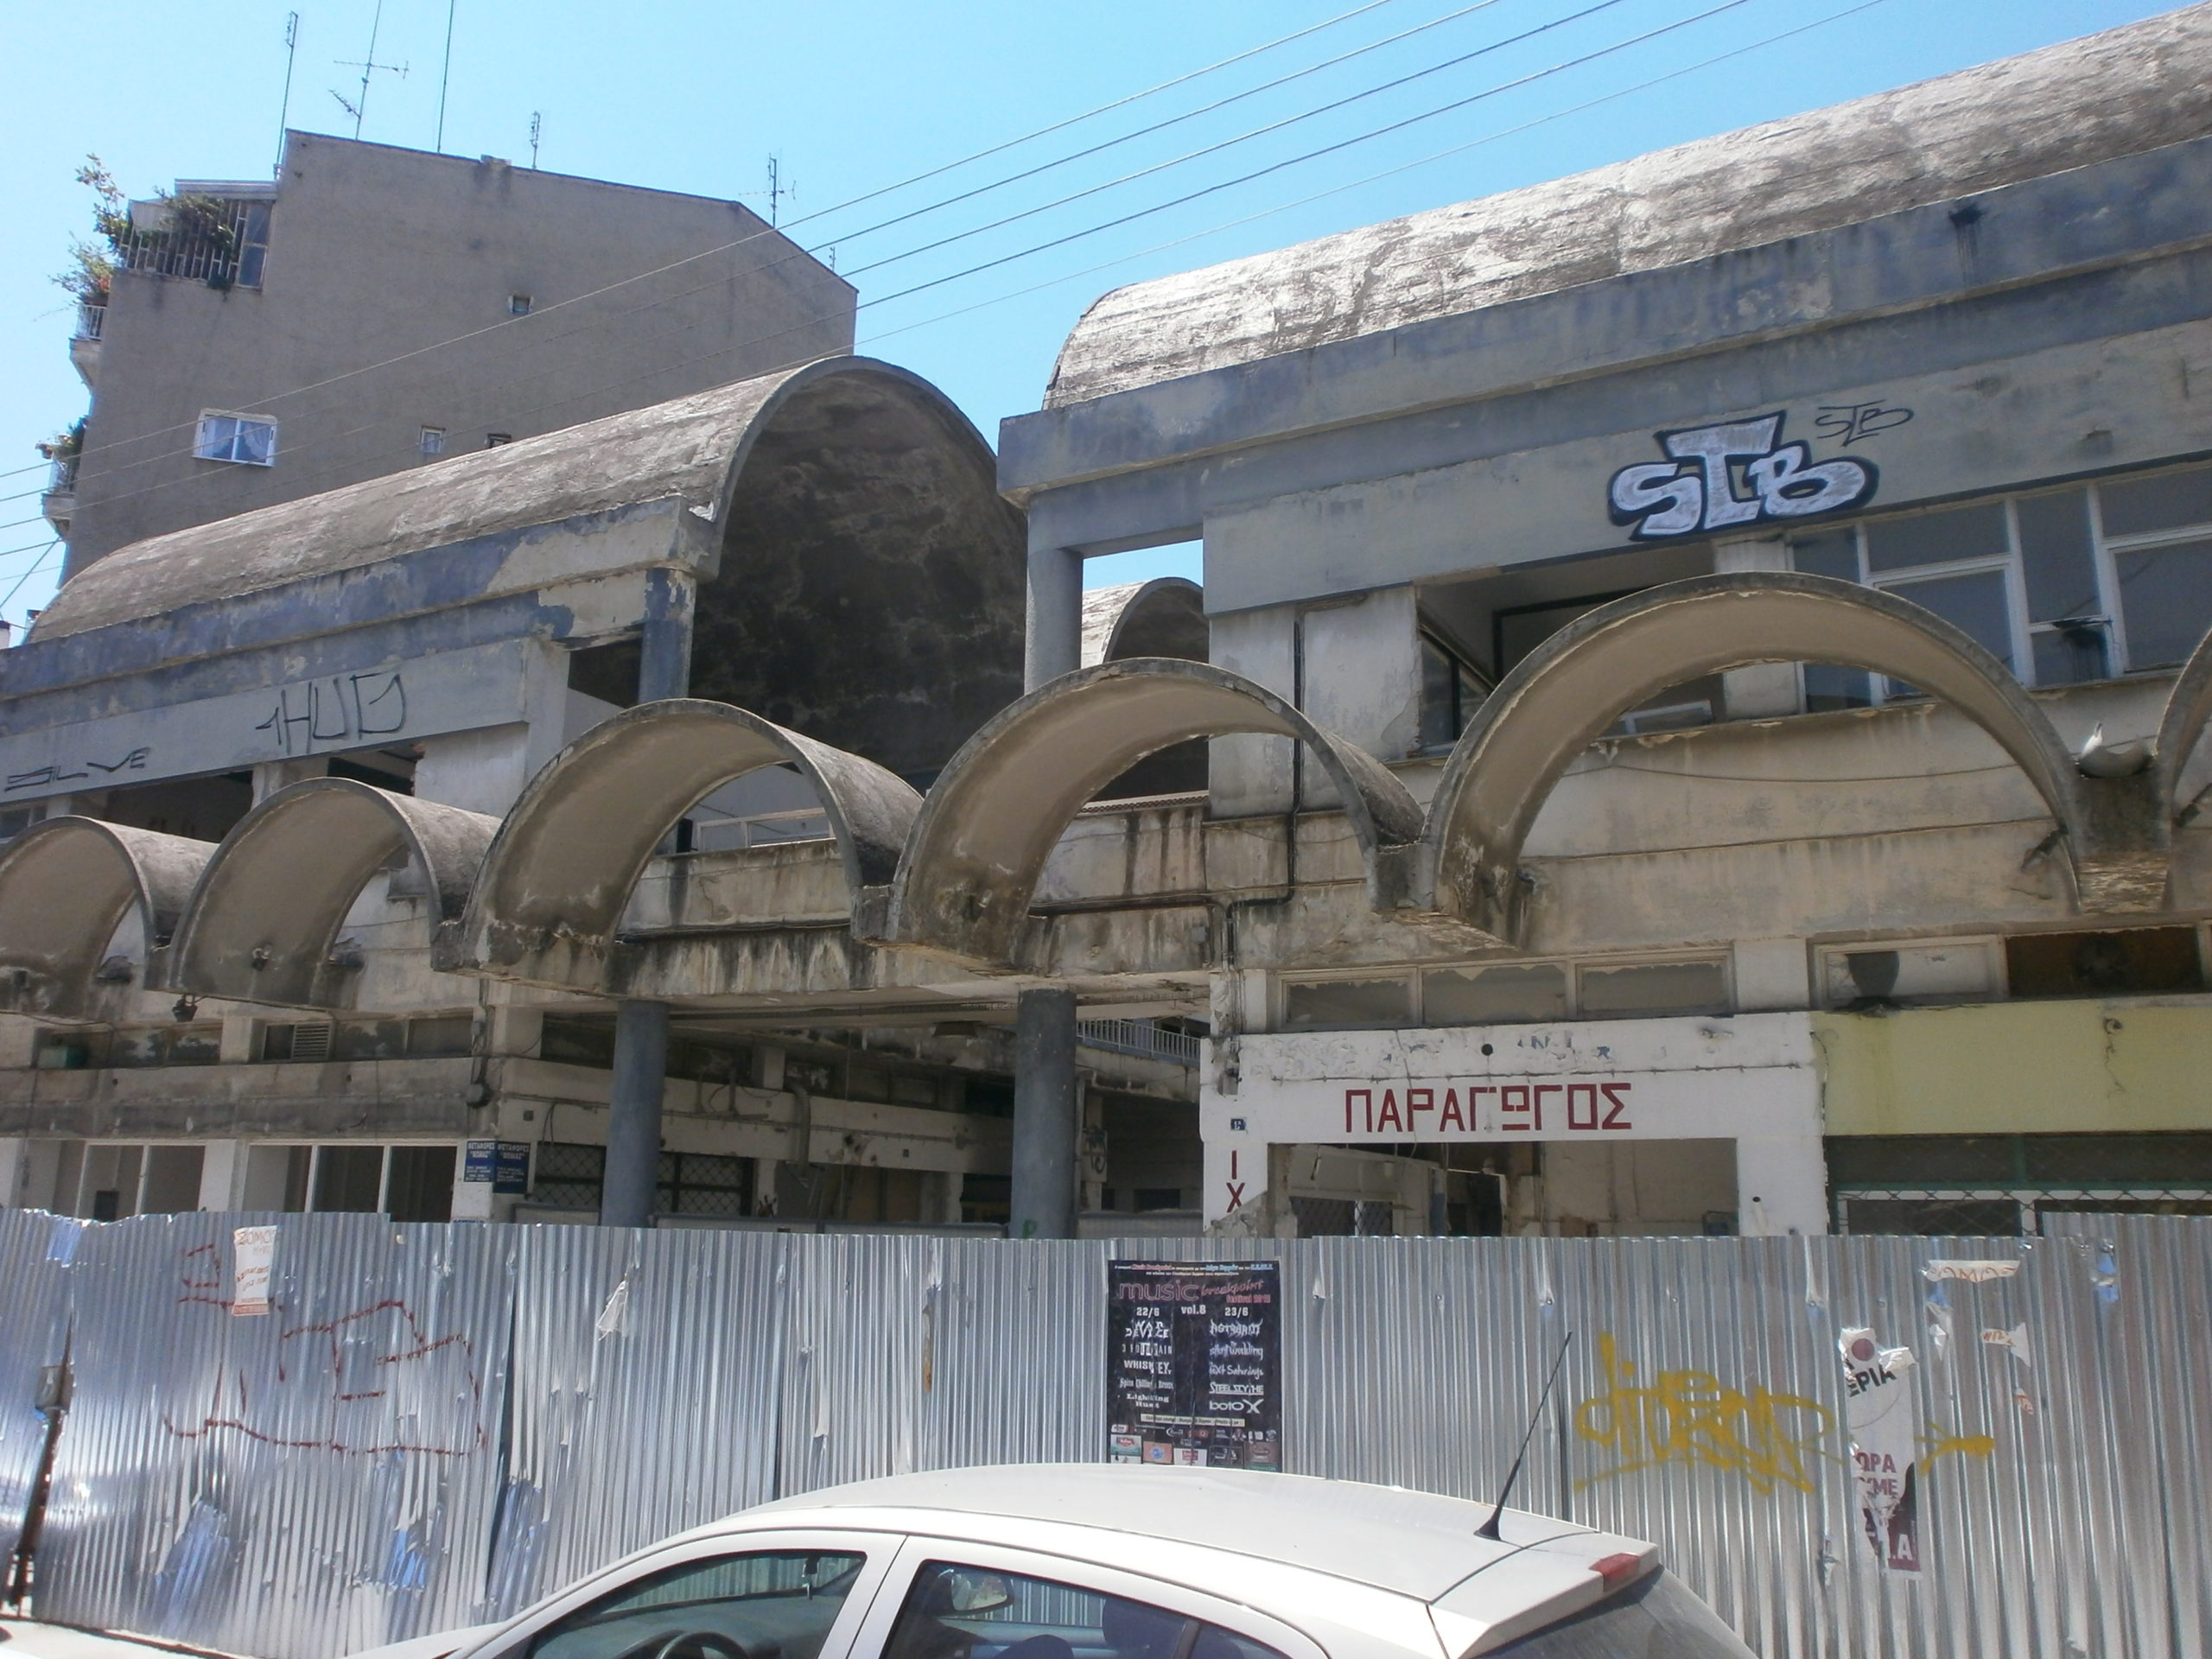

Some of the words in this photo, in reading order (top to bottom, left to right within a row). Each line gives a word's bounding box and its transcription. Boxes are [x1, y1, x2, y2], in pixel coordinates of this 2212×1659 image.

[1119, 1279, 1199, 1301] music
[1136, 1306, 1160, 1318] 22/6
[1180, 1305, 1207, 1315] vol.8
[1224, 1306, 1249, 1318] 23/6
